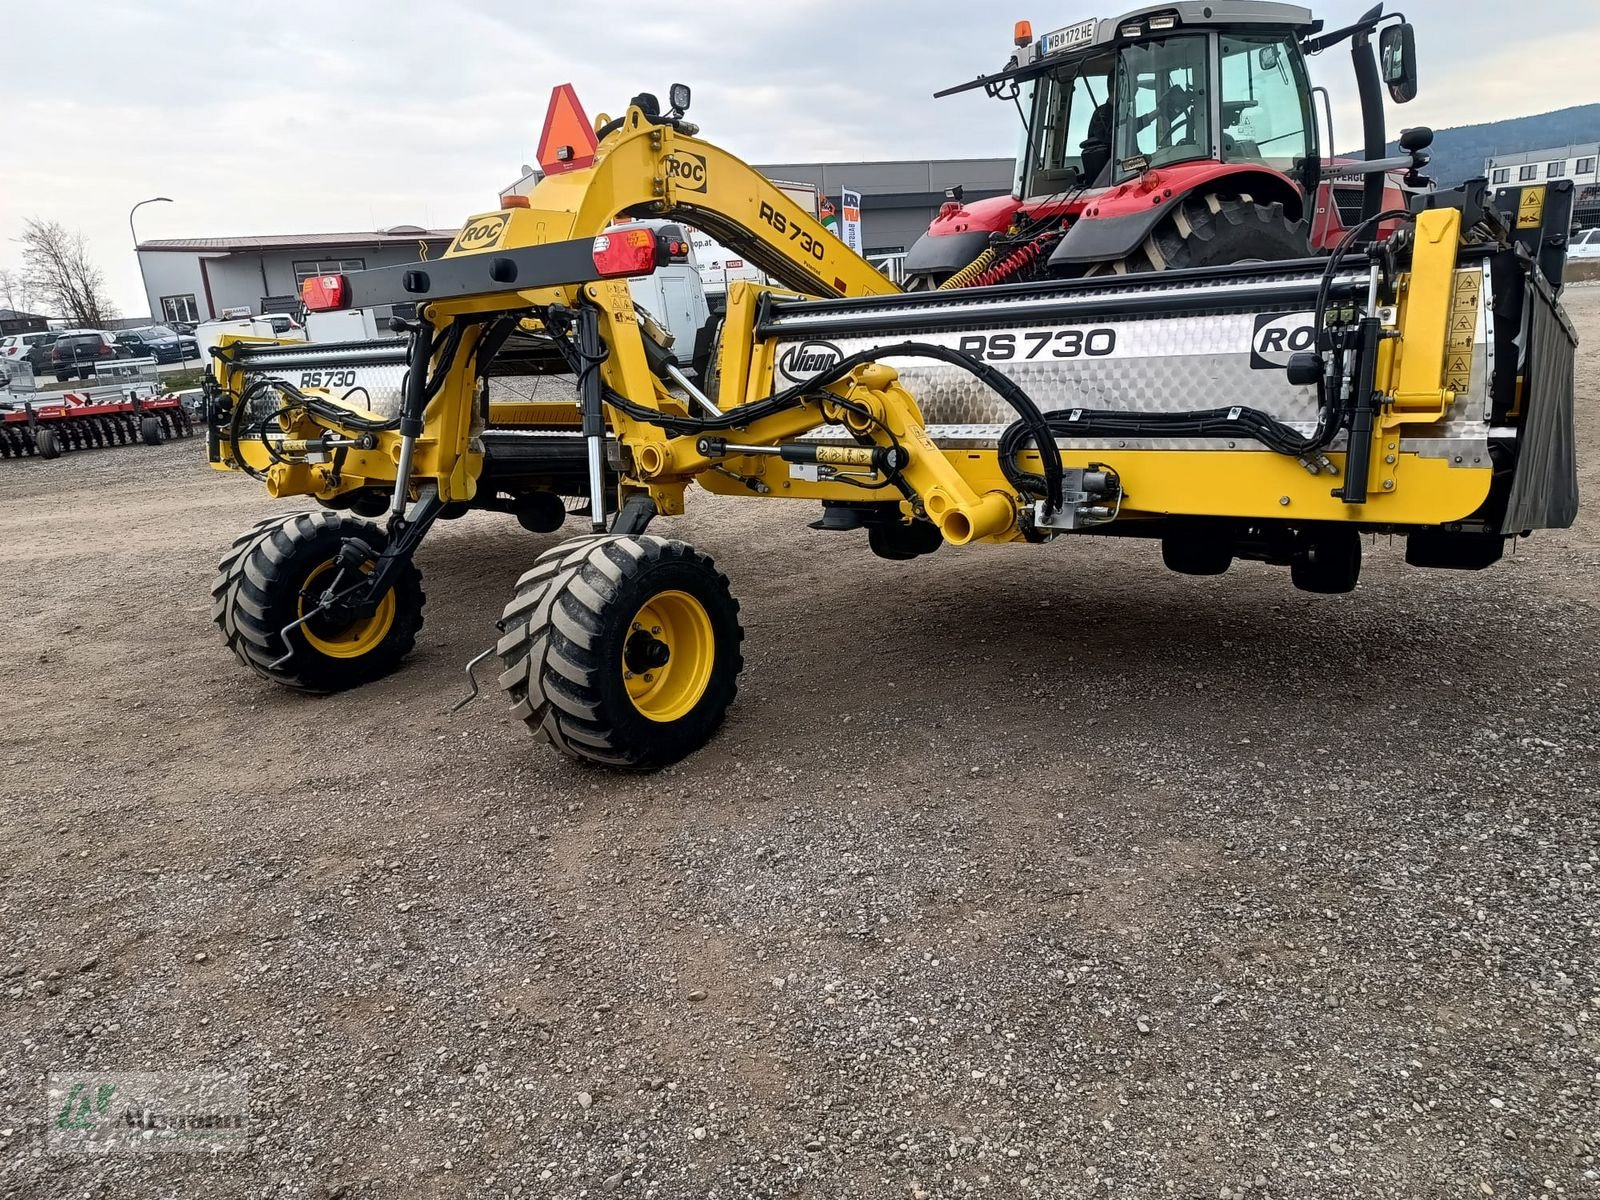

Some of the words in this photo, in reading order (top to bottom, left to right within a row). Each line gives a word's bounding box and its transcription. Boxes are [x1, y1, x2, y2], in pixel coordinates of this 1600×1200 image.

[1065, 28, 1080, 43] 172
[1081, 23, 1093, 39] HE
[668, 158, 704, 182] ROC
[461, 222, 503, 243] ROC
[759, 200, 787, 234] RS
[788, 221, 825, 261] 730
[694, 239, 712, 250] op.at
[959, 334, 1016, 361] RS
[1025, 328, 1117, 360] 730
[1259, 325, 1315, 352] RO
[786, 345, 837, 372] Vicon
[300, 372, 322, 388] RS
[323, 370, 356, 388] 730
